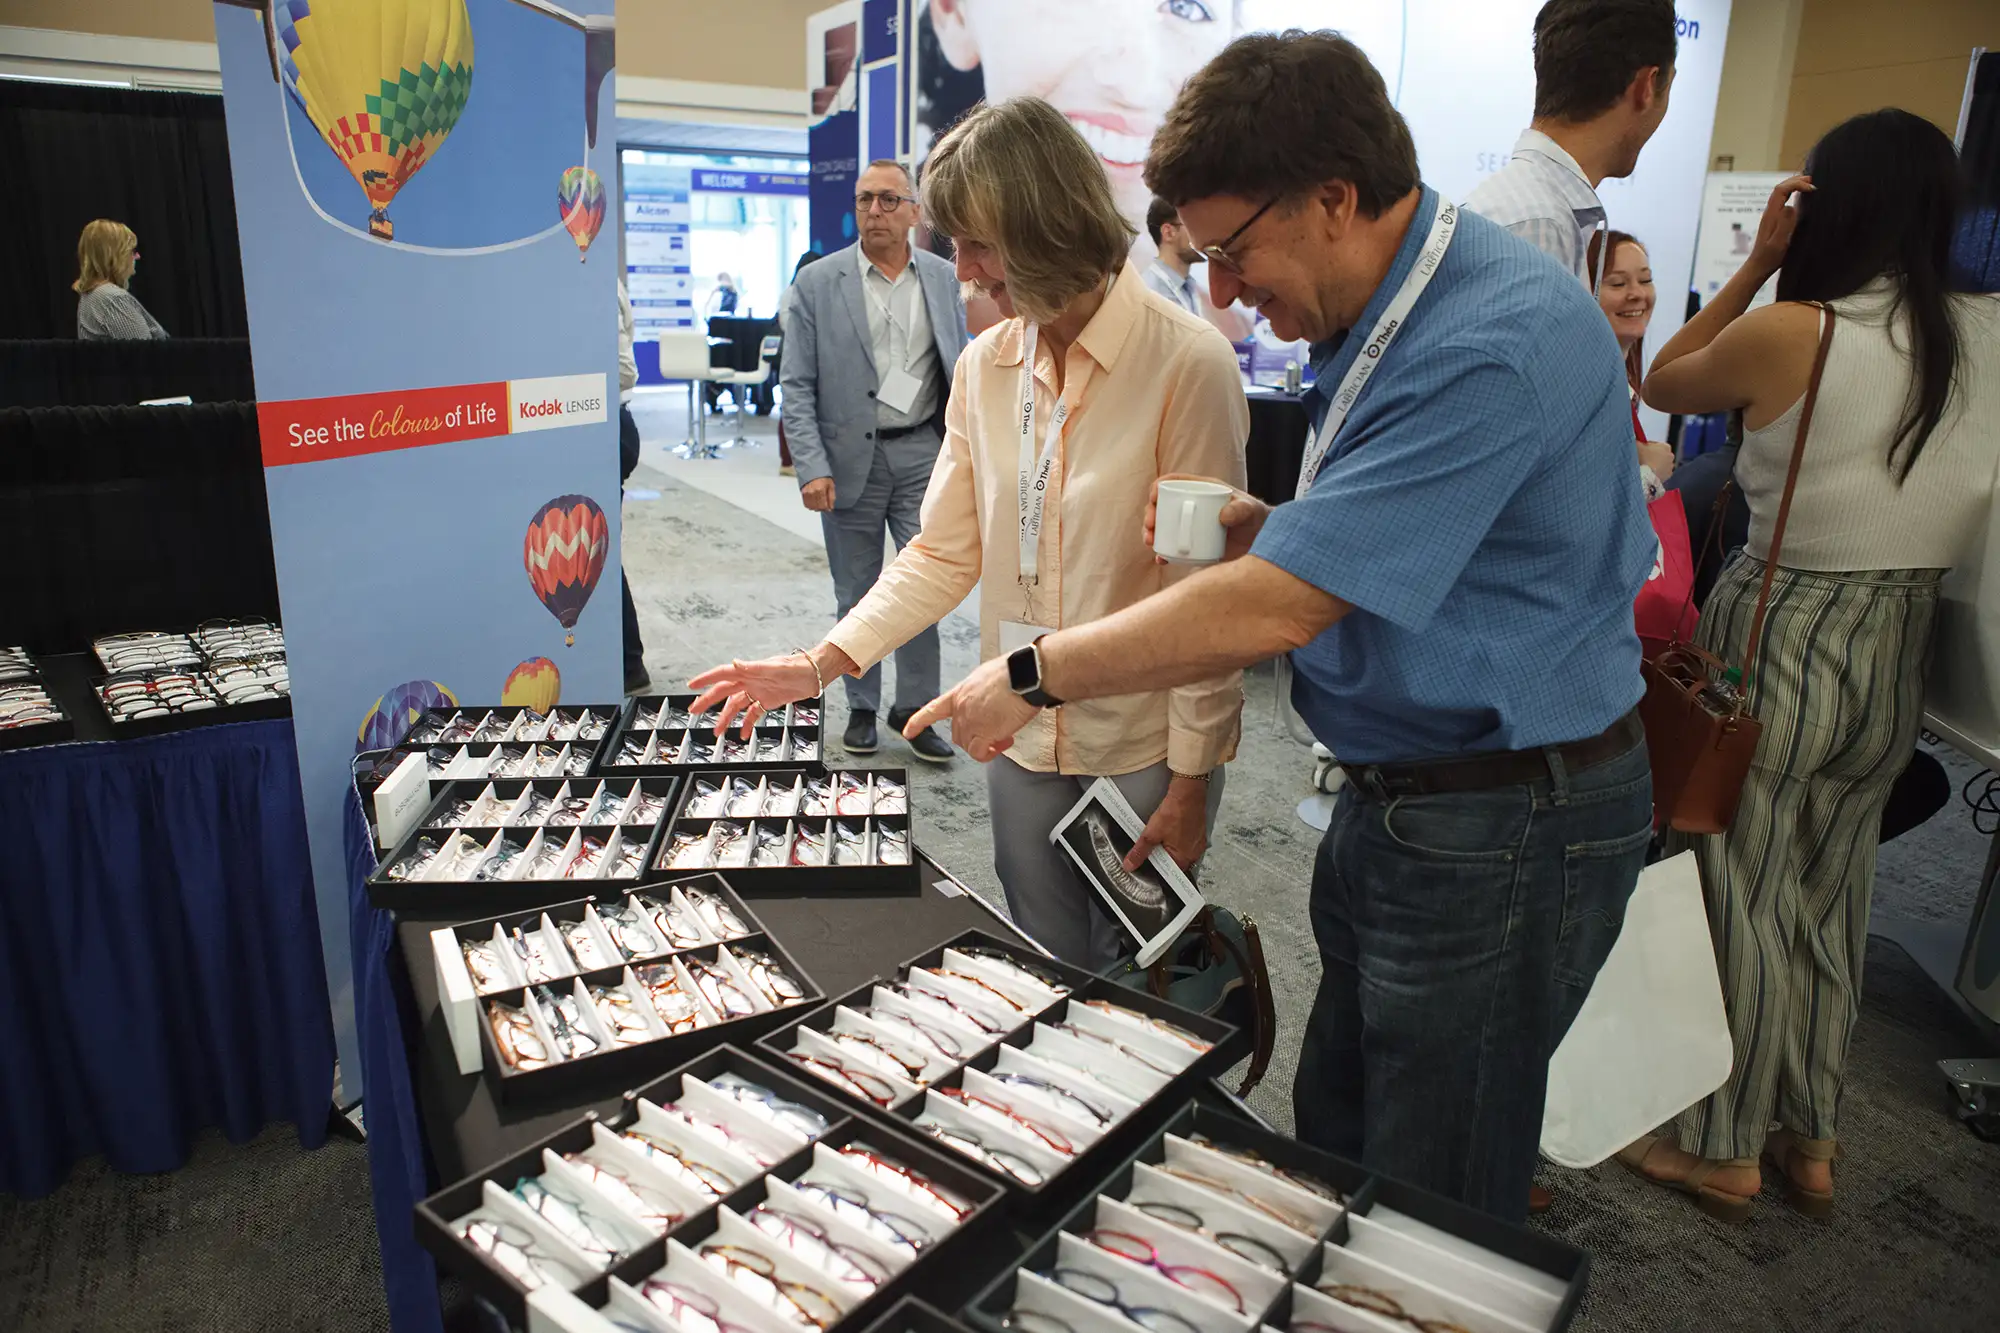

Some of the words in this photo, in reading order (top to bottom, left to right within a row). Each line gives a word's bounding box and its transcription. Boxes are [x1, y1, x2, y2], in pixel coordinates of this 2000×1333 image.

[701, 173, 747, 188] WELCOME
[1337, 363, 1372, 413] LABTICIAN
[1376, 319, 1398, 346] Théa
[288, 423, 329, 448] See
[334, 417, 365, 441] the
[369, 405, 443, 438] Colours
[445, 405, 463, 427] of
[467, 401, 497, 425] Life
[519, 398, 563, 419] Kodak
[566, 398, 601, 414] LENSES
[1022, 414, 1031, 435] Théa
[1020, 470, 1029, 512] LABTICIAN
[1030, 495, 1043, 536] LABTICIAN
[1039, 459, 1051, 480] Théa
